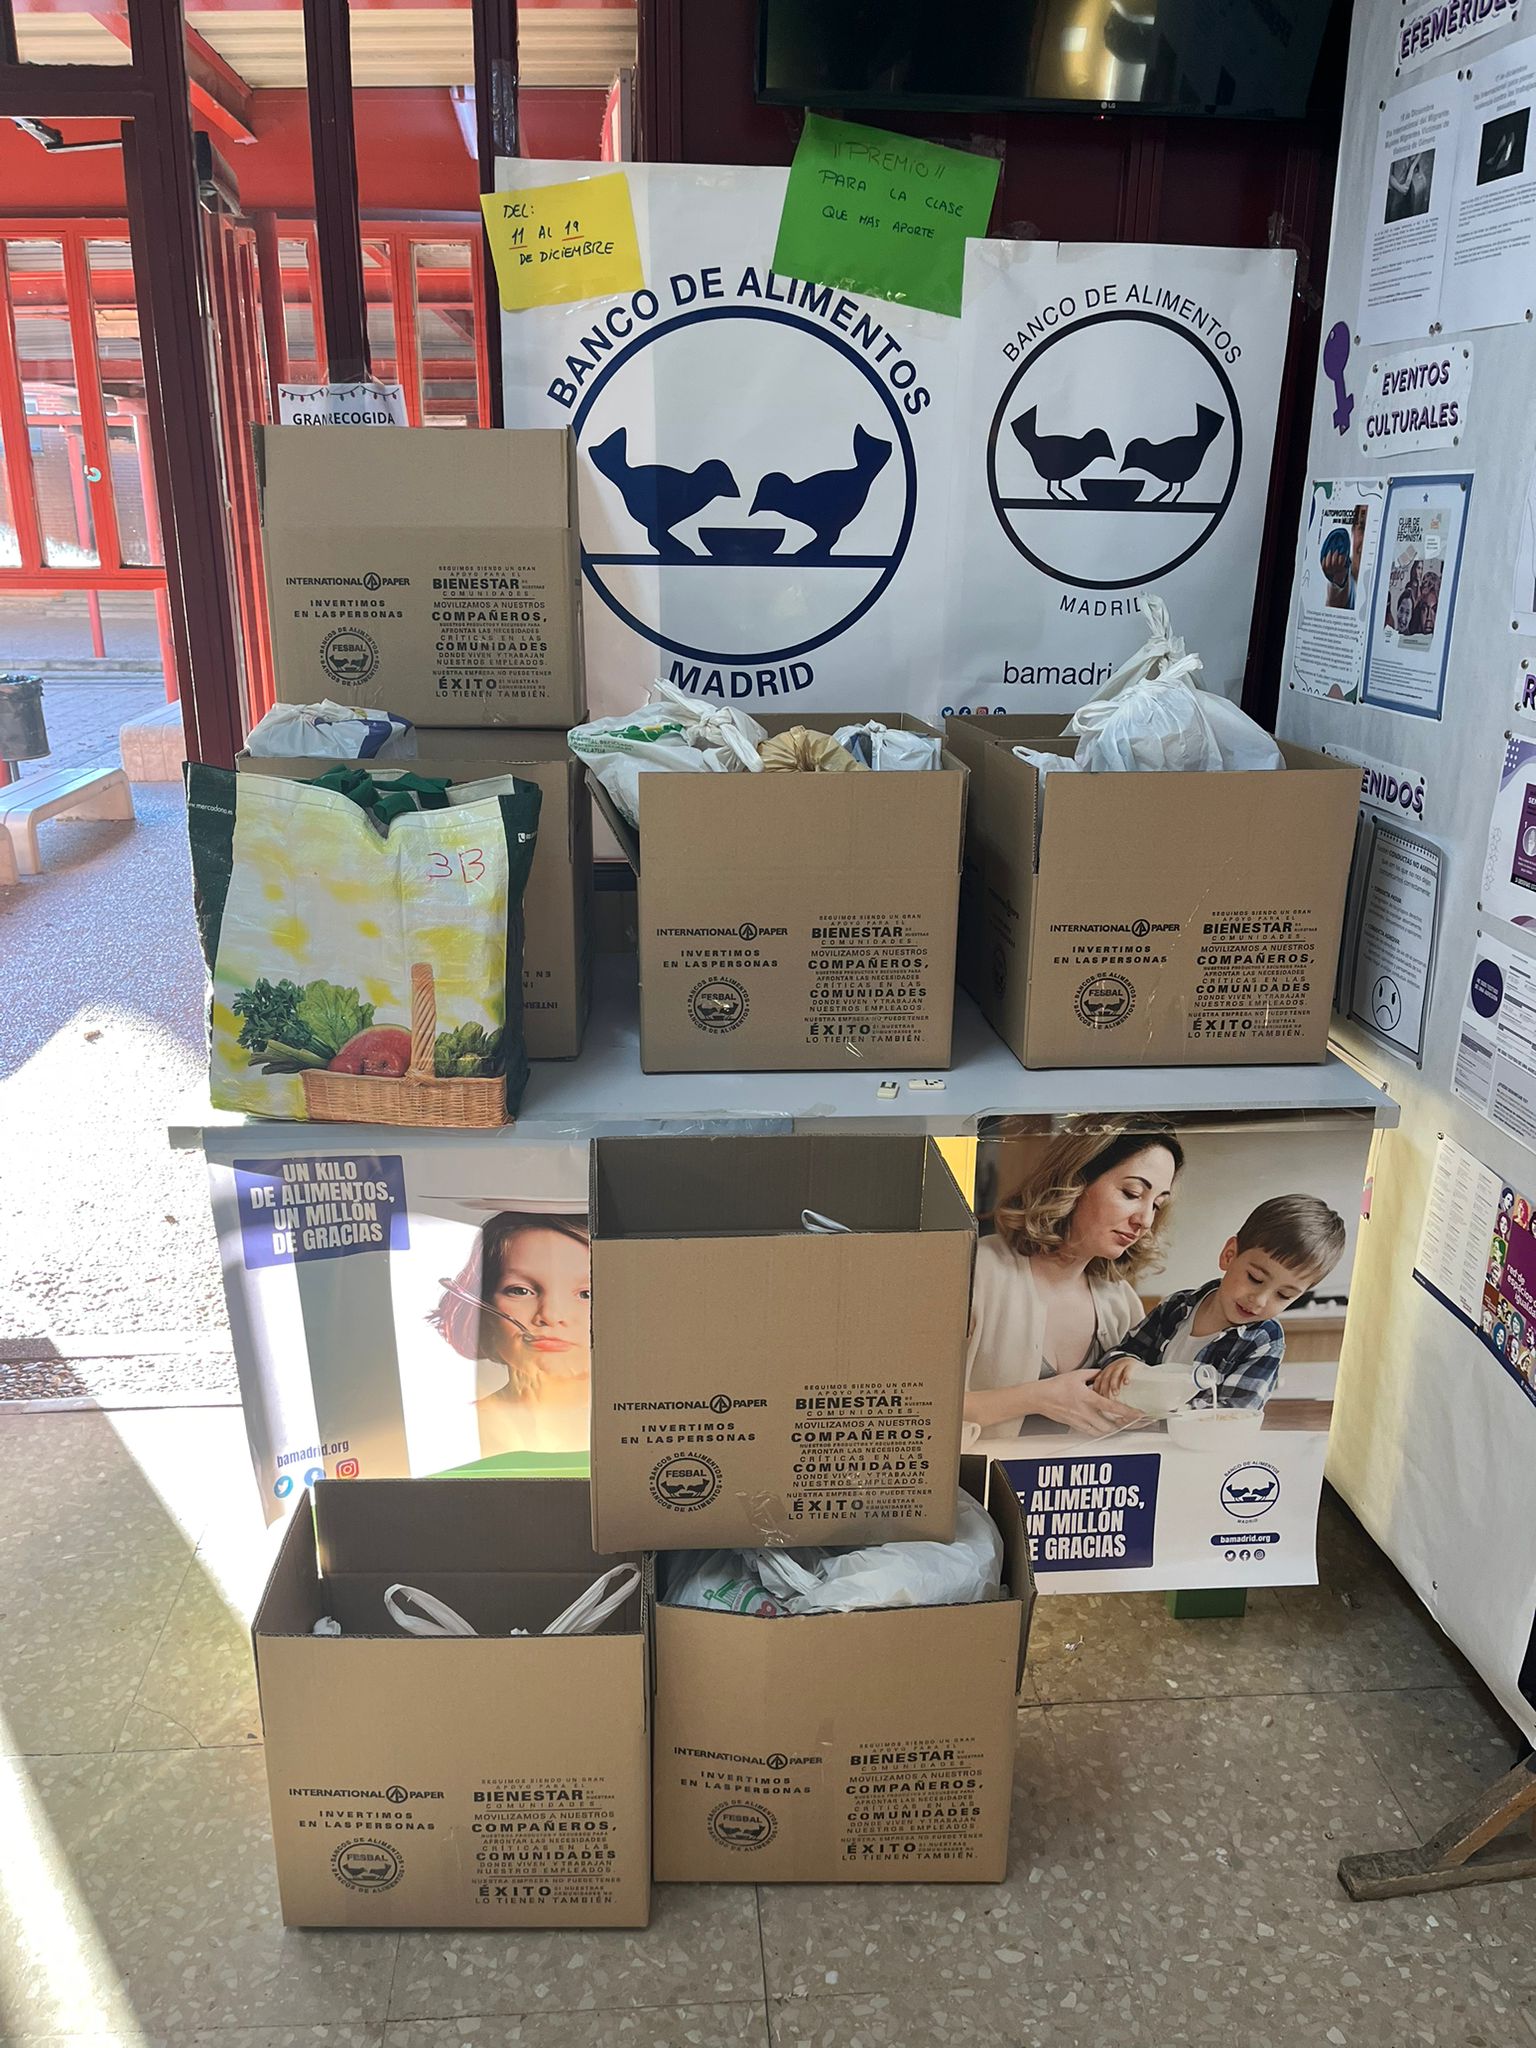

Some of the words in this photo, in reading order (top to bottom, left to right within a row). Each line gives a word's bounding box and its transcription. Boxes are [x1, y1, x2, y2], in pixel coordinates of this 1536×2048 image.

[1401, 0, 1518, 59] EFEMERID
[819, 169, 867, 192] PARA
[890, 188, 907, 202] LA
[925, 196, 964, 218] CLASE
[822, 205, 848, 221] QUE
[892, 221, 935, 239] APORTE
[511, 227, 525, 245] 11
[538, 225, 552, 239] AL
[564, 220, 580, 235] 19
[520, 252, 533, 265] DE
[1003, 297, 1076, 362] BANCO
[1085, 284, 1118, 308] DE
[1125, 284, 1242, 364] ALIMENTOS
[547, 289, 659, 409] BANCO
[669, 267, 725, 307] DE
[737, 267, 931, 415] ALIMENTOS
[1382, 360, 1451, 396] EVENTOS
[1366, 401, 1459, 438] CULTURALES
[286, 577, 362, 586] INTERNATIONAL
[382, 578, 410, 586] PAPER
[433, 579, 519, 589] BIENESTAR
[432, 610, 547, 622] COMPAÑEROS,
[332, 644, 366, 652] FESBAL
[436, 642, 547, 651] COMUNIDADES
[439, 676, 497, 689] ÉXITO
[669, 660, 814, 698] MADRID
[499, 689, 550, 698] TAMBIÉN.
[812, 927, 903, 938] BIENESTAR
[1203, 922, 1292, 934] BIENESTAR
[1201, 945, 1259, 953] MOVILIZAMOS
[808, 957, 929, 969] COMPAÑEROS,
[1197, 953, 1315, 965] COMPAÑEROS,
[810, 988, 927, 998] COMUNIDADES
[1089, 989, 1123, 997] FESBAL
[1196, 983, 1310, 993] COMUNIDADES
[810, 1023, 870, 1035] ÉXITO
[1193, 1018, 1252, 1030] ÉXITO
[871, 1034, 925, 1042] TAMBIÉN.
[1252, 1029, 1305, 1037] TAMBIÉN.
[283, 1163, 310, 1183] UN
[314, 1161, 358, 1181] KILO
[250, 1186, 276, 1209] DE
[282, 1181, 395, 1206] ALIMENTOS,
[273, 1208, 300, 1230] UN
[305, 1199, 377, 1227] MILLÓN
[272, 1232, 298, 1255] DE
[303, 1222, 383, 1251] GRACIAS
[613, 1401, 709, 1411] INTERNATIONAL
[733, 1399, 767, 1408] PAPER
[796, 1396, 902, 1409] BIENESTAR
[642, 1423, 735, 1432] INVERTIMOS
[795, 1421, 864, 1429] MOVILIZAMOS
[878, 1419, 931, 1427] NUESTROS
[791, 1429, 932, 1442] COMPAÑEROS,
[276, 1440, 350, 1468] bamadrid.org
[793, 1461, 929, 1472] COMUNIDADES
[666, 1470, 707, 1478] FESBAL
[1037, 1465, 1065, 1488] UN
[1069, 1463, 1113, 1487] KILO
[1030, 1485, 1145, 1512] ALIMENTOS,
[794, 1498, 864, 1512] ÉXITO
[864, 1510, 926, 1518] TAMBIÉN.
[1052, 1504, 1124, 1535] MILLÓN
[1220, 1534, 1271, 1544] bamadrid.org
[1044, 1533, 1127, 1561] GRACIAS
[674, 1747, 766, 1765] INTERNATIONAL
[851, 1750, 954, 1765] BIENESTAR
[701, 1771, 790, 1784] INVERTIMOS
[846, 1779, 983, 1795] COMPAÑEROS,
[289, 1788, 385, 1799] INTERNATIONAL
[410, 1791, 444, 1799] PAPER
[474, 1790, 583, 1802] BIENESTAR
[320, 1811, 413, 1819] INVERTIMOS
[723, 1814, 762, 1823] FESBAL
[847, 1808, 980, 1821] COMUNIDADES
[472, 1821, 616, 1832] COMPAÑEROS,
[847, 1841, 916, 1854] ÉXITO
[347, 1854, 388, 1862] FESBAL
[476, 1851, 616, 1861] COMUNIDADES
[480, 1884, 551, 1896] ÉXITO
